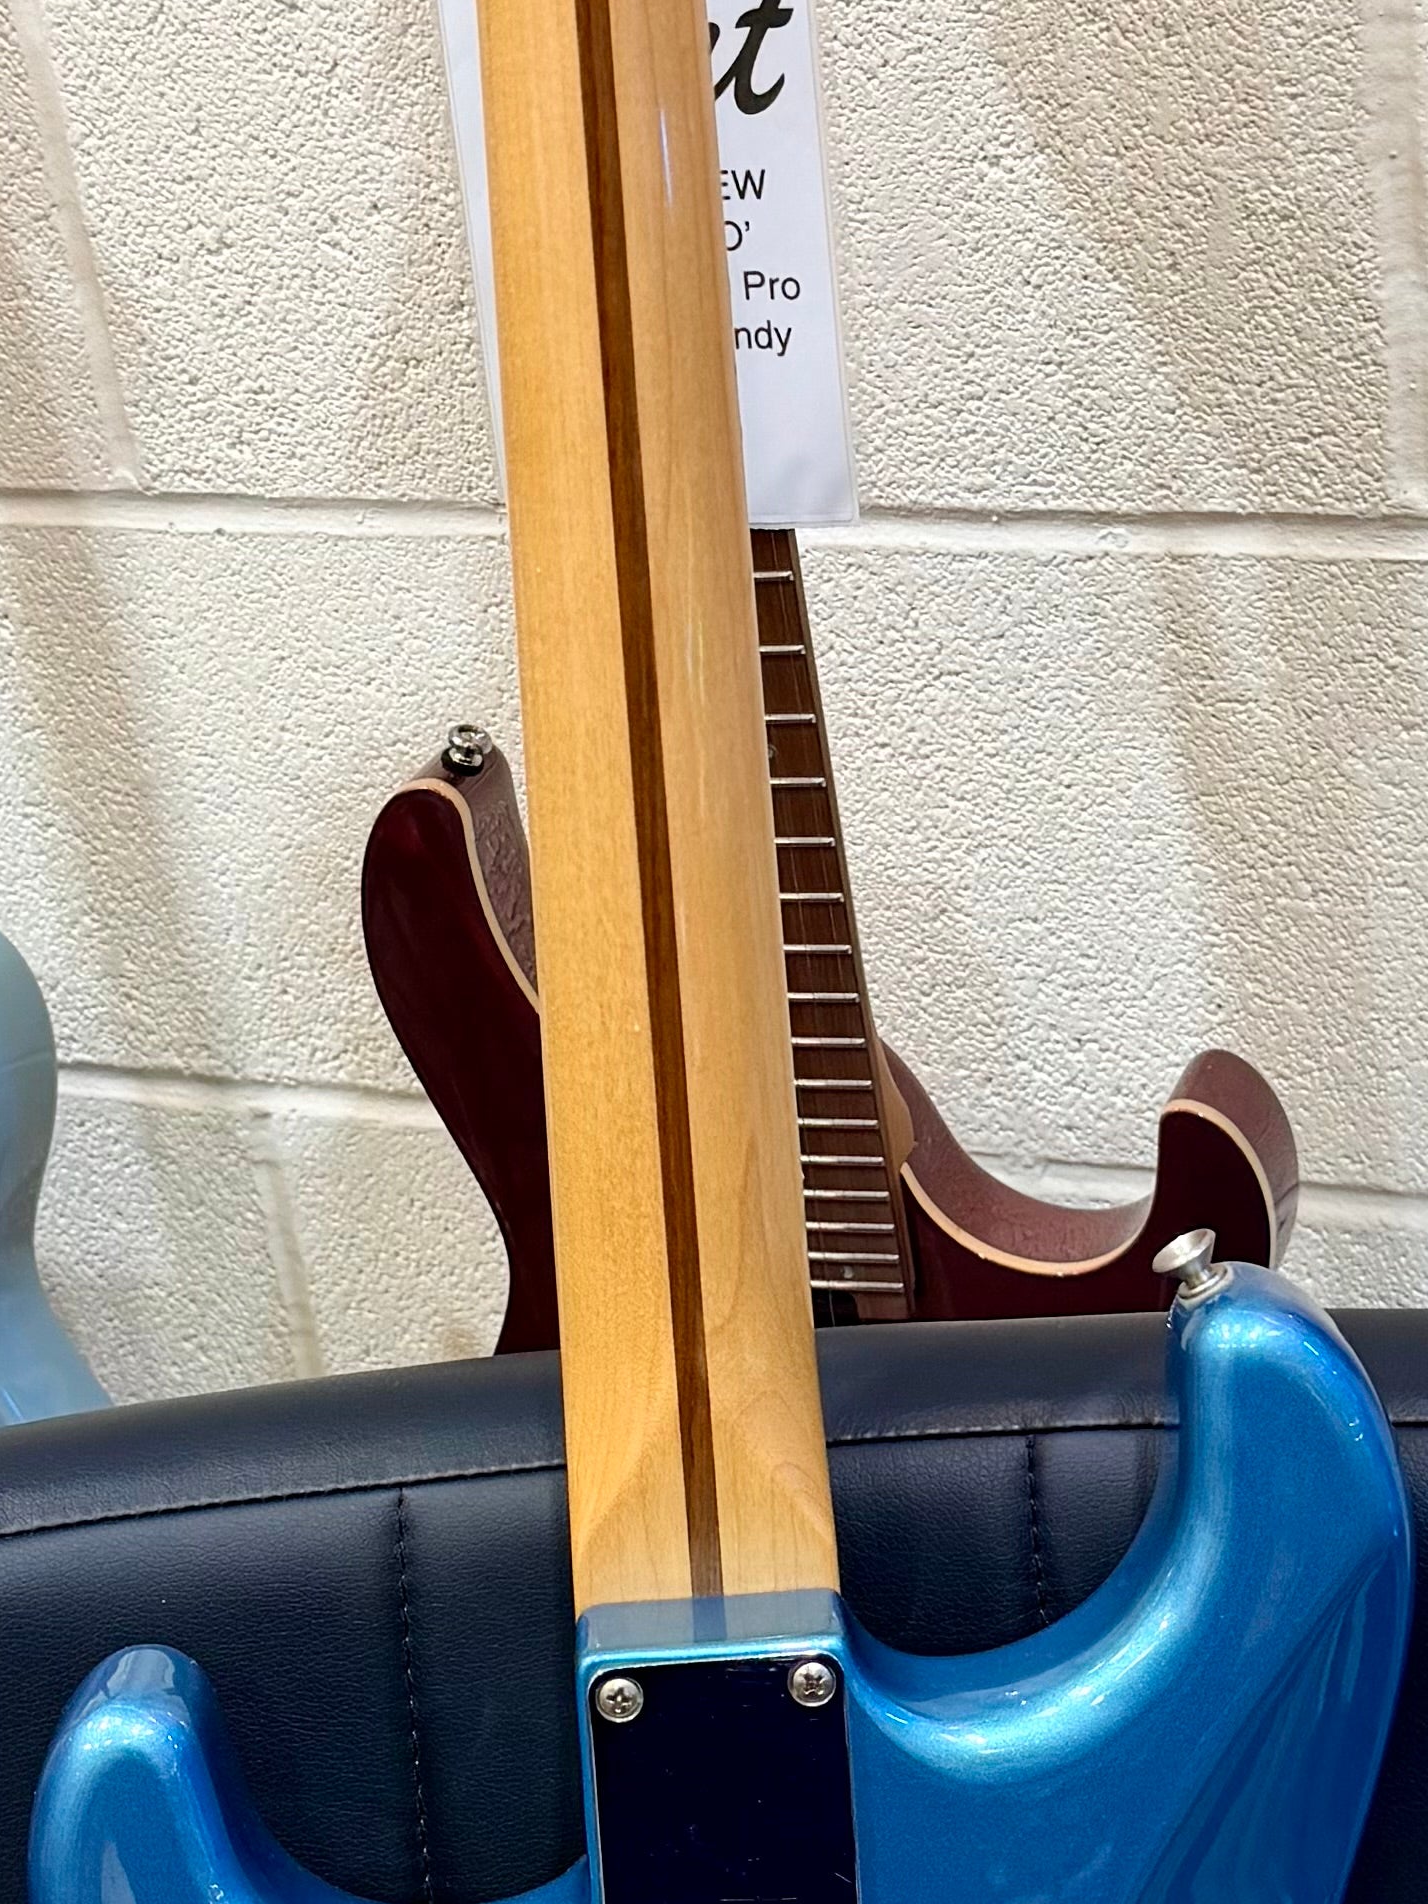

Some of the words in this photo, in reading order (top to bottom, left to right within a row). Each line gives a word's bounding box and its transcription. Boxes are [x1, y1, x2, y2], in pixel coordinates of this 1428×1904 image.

[719, 168, 766, 201] EW
[743, 270, 801, 301] Pro
[733, 319, 793, 357] ndy
